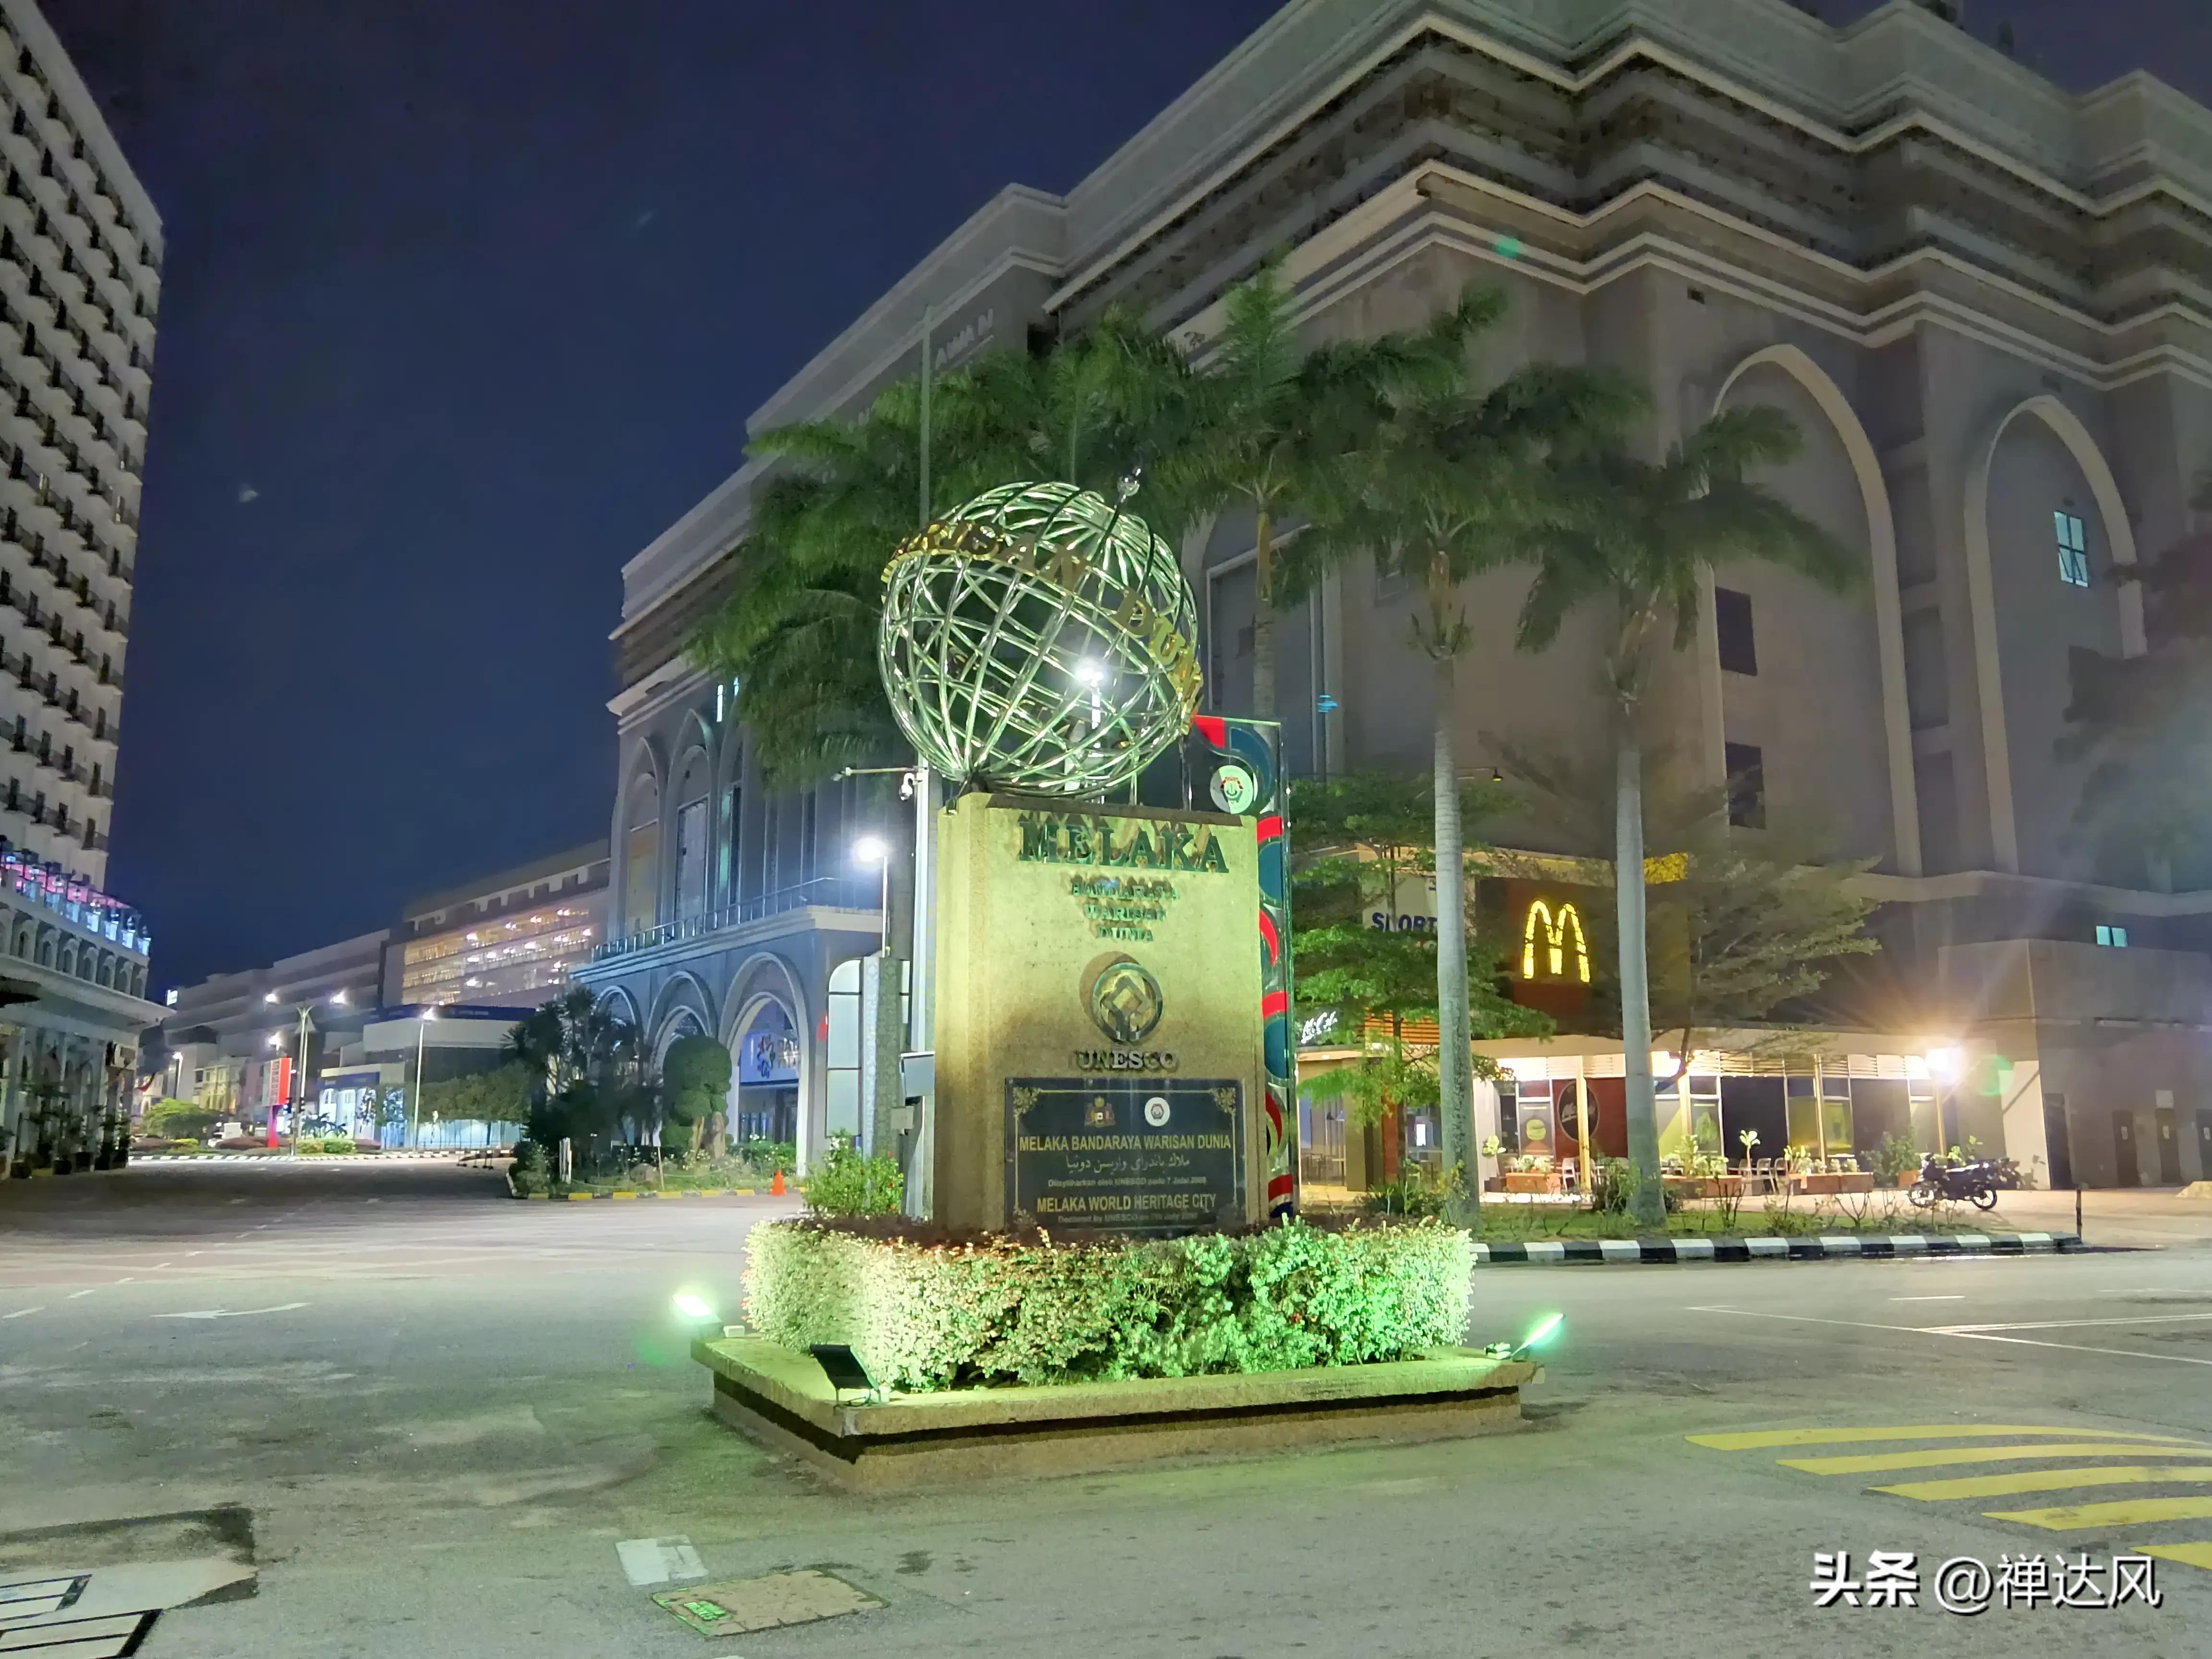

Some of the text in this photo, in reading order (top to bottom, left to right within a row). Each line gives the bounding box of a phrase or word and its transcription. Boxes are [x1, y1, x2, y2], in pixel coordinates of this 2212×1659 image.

[1019, 821, 1229, 873] MELAKA
[1072, 882, 1180, 900] BANDARAYA
[1083, 904, 1167, 922] WARISAN
[1098, 927, 1153, 941] DUNIA
[1077, 1050, 1178, 1069] UNESCO
[1019, 1134, 1231, 1151] MELAKA BANDARAYA WARISAN DUNIA
[1037, 1193, 1216, 1213] MELAKA WORLD HERITAGE CITY
[1105, 1213, 1138, 1222] UNESCO
